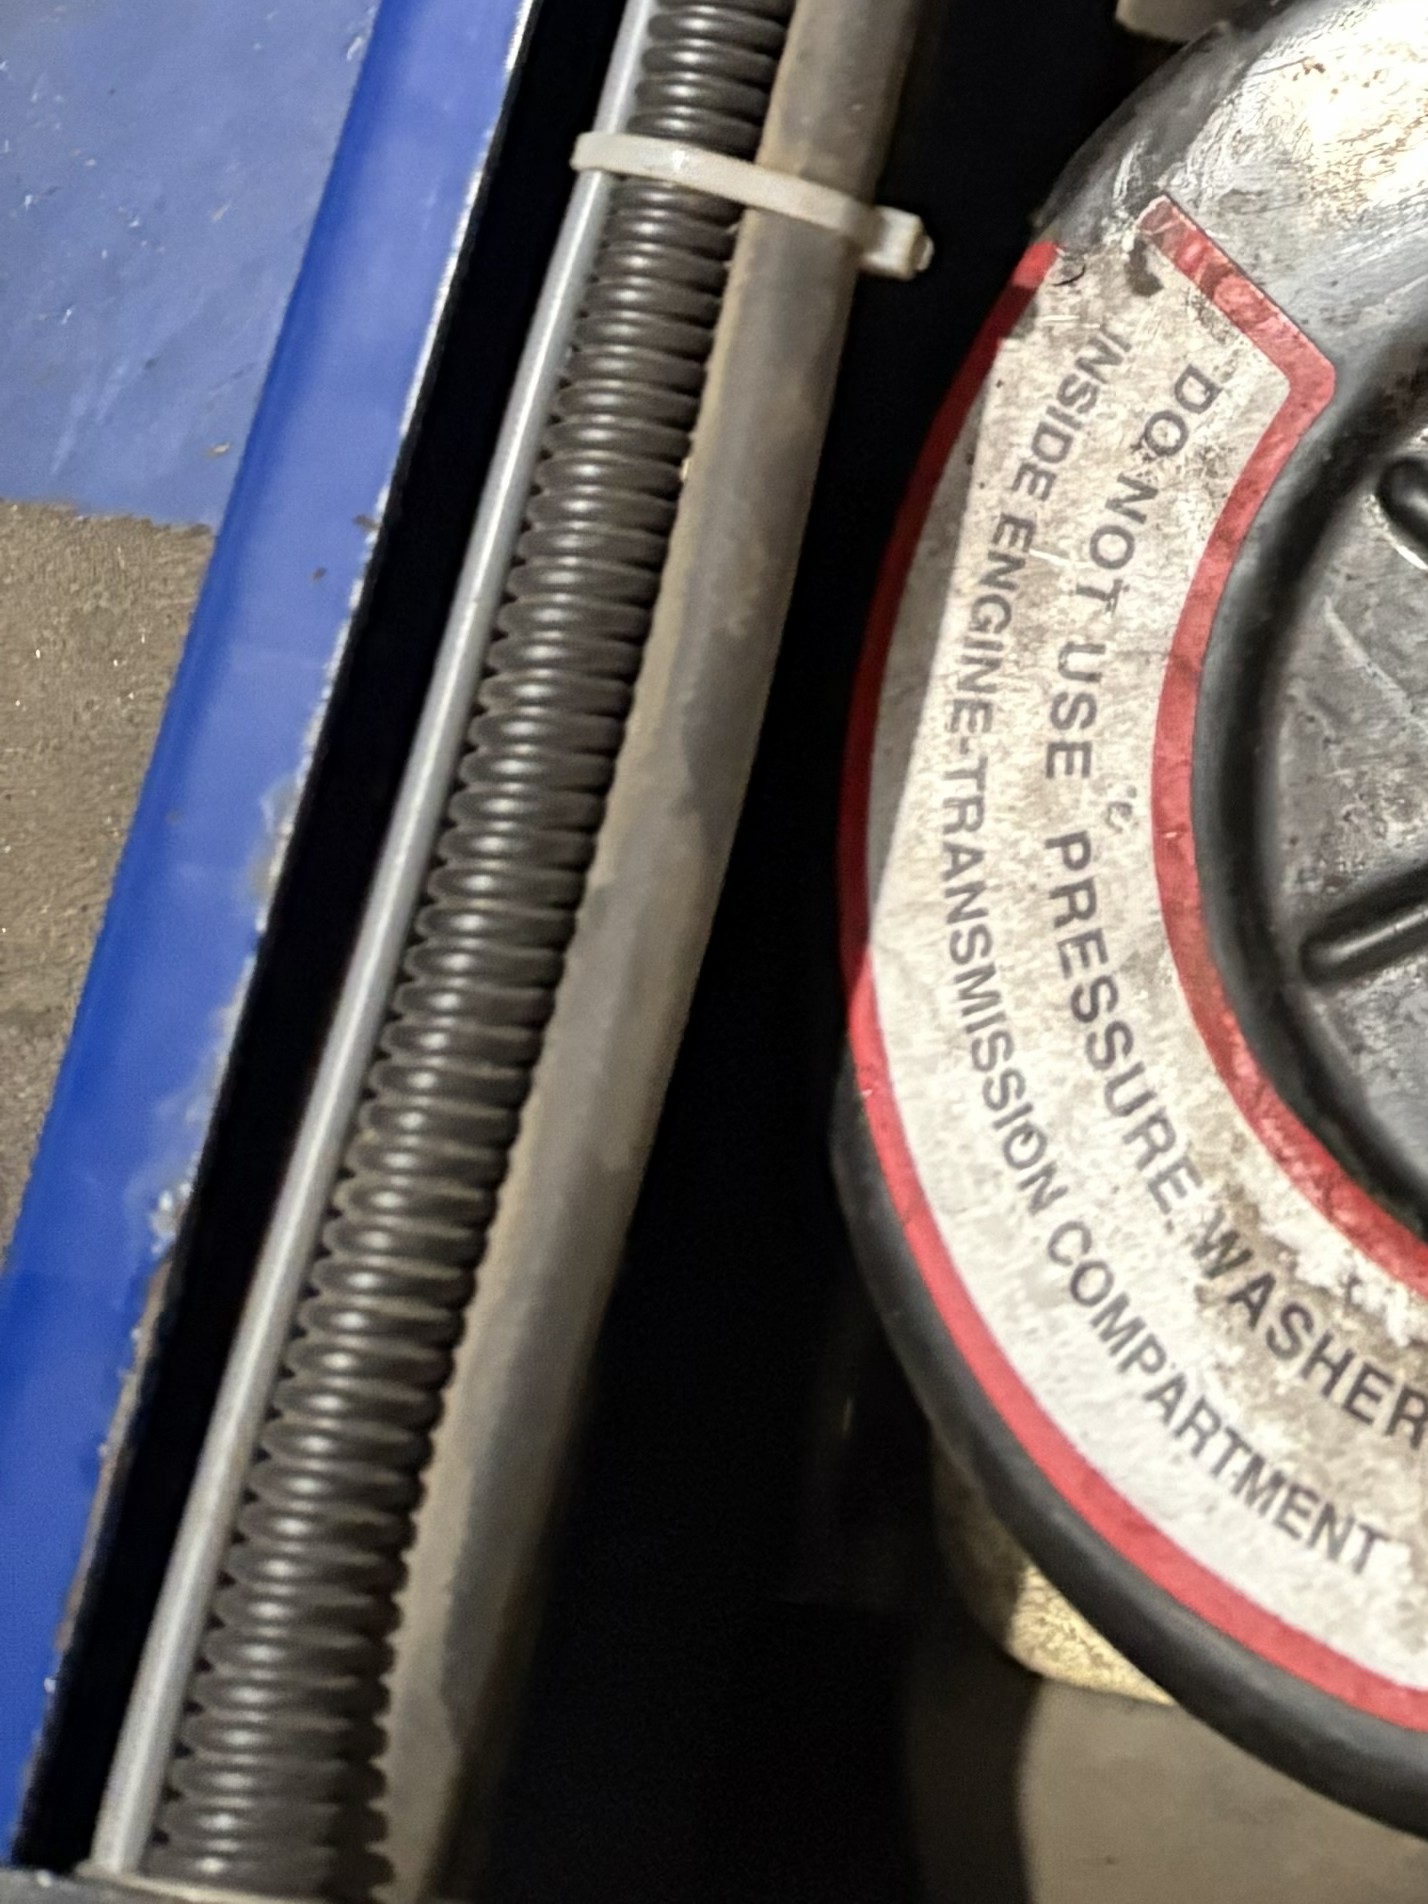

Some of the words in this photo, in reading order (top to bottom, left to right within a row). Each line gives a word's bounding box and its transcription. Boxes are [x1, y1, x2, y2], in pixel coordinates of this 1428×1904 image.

[1010, 324, 1133, 504] INSIDE
[1142, 363, 1225, 458] DO
[1075, 471, 1161, 619] NOT
[1045, 640, 1108, 781] USE
[939, 512, 1068, 1216] ENGINE-TRANSMISSION
[1043, 830, 1202, 1220] PRESSURE
[1045, 1216, 1390, 1577] COMPARTMENT
